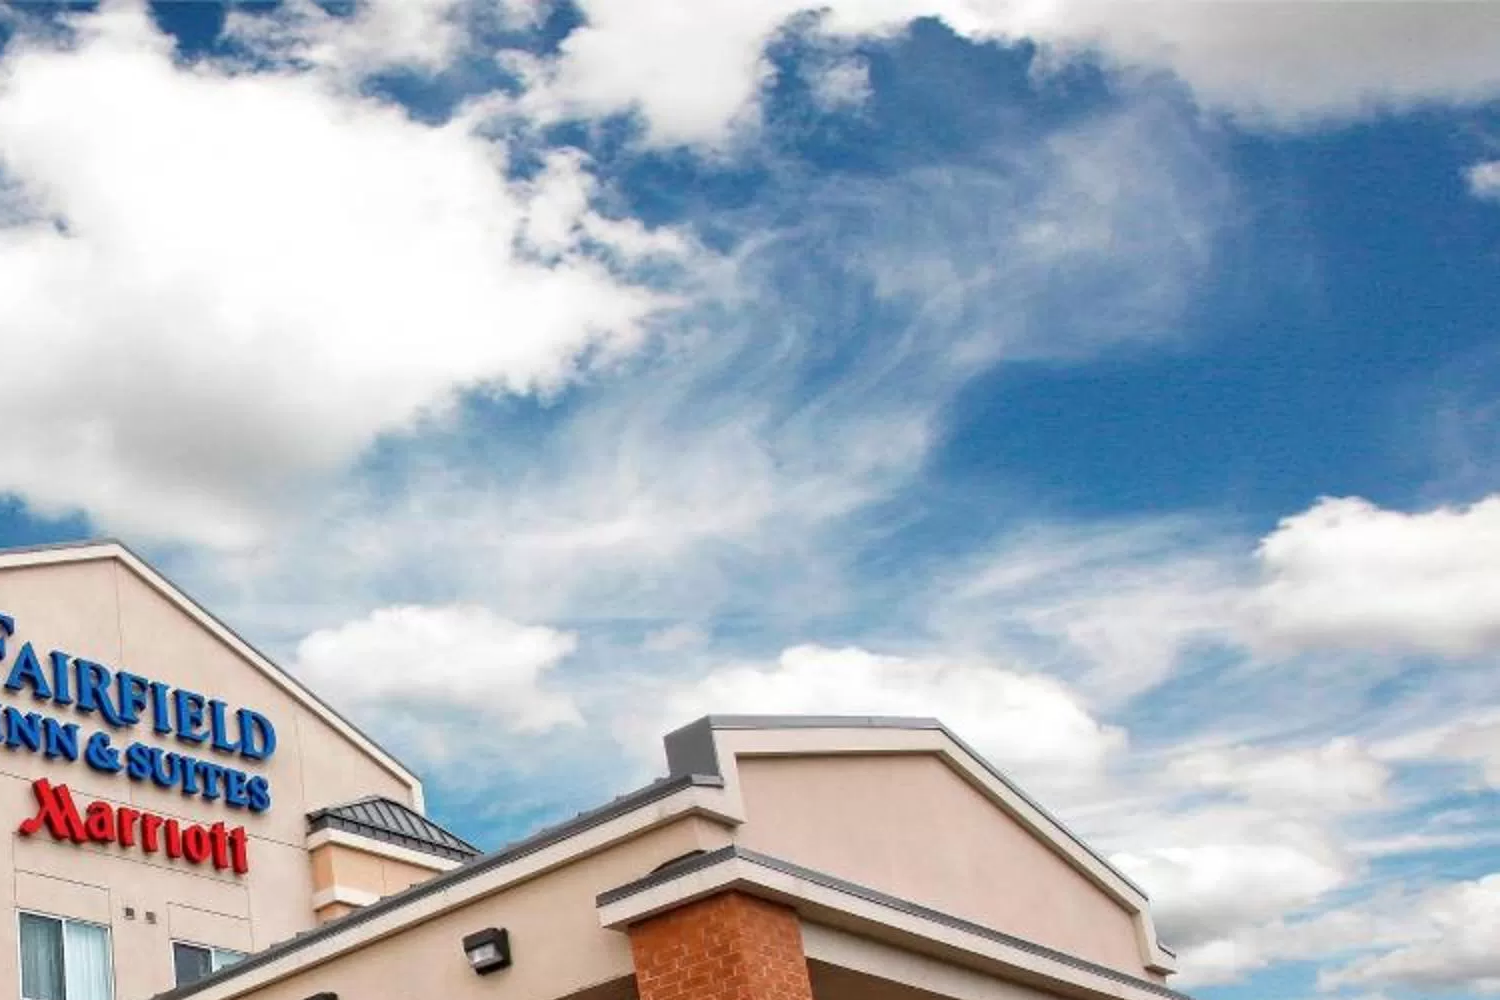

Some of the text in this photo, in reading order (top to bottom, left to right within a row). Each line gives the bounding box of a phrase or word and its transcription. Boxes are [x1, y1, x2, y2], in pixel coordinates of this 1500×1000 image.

[84, 730, 122, 773] &
[126, 741, 271, 813] SUITES
[18, 777, 249, 875] Marriott
